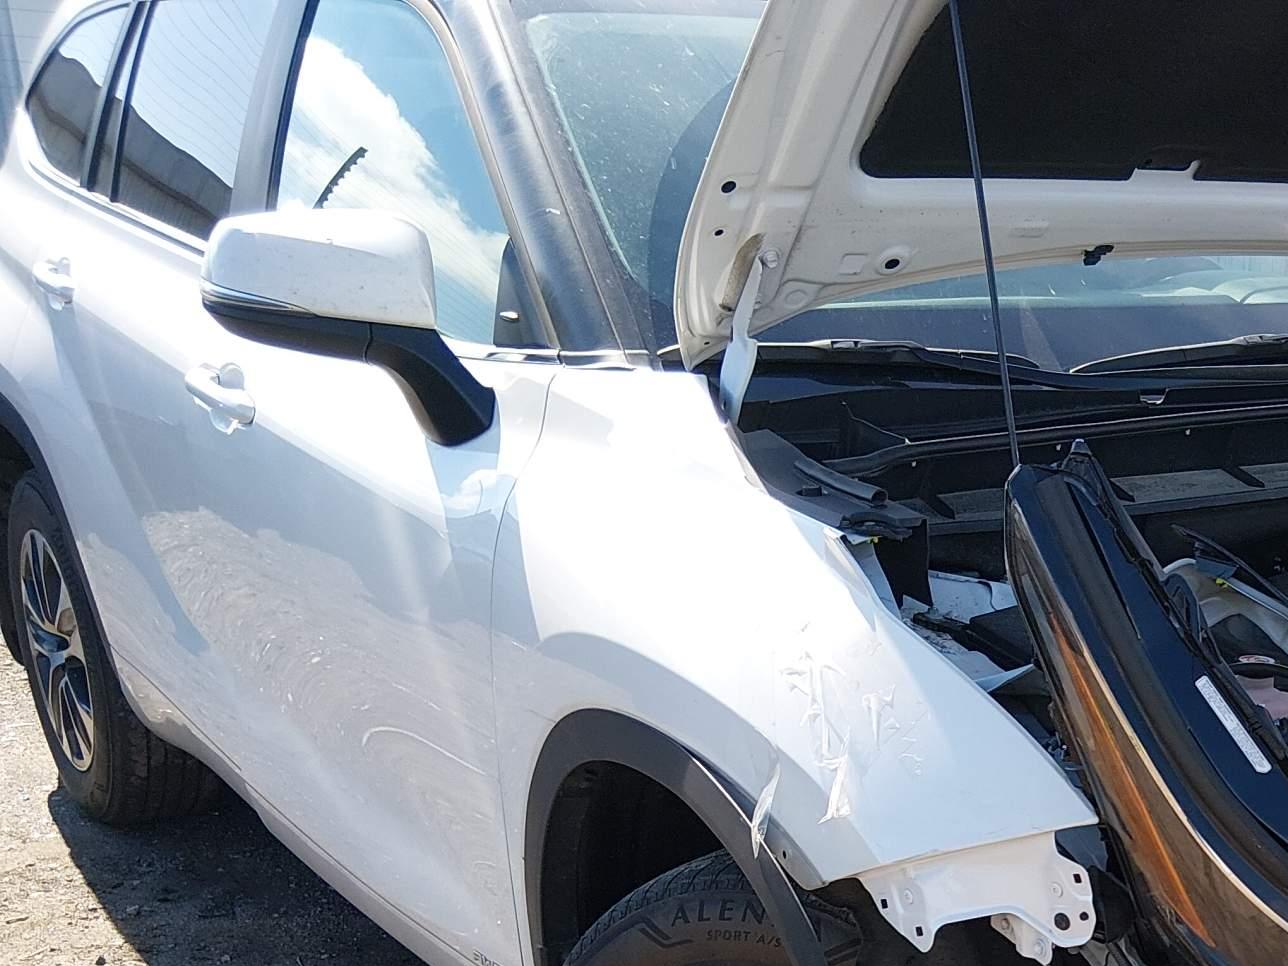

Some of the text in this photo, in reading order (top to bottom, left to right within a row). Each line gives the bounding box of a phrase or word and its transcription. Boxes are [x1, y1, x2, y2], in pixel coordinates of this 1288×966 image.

[671, 899, 776, 928] ALEN
[706, 930, 782, 948] SPORT A/S
